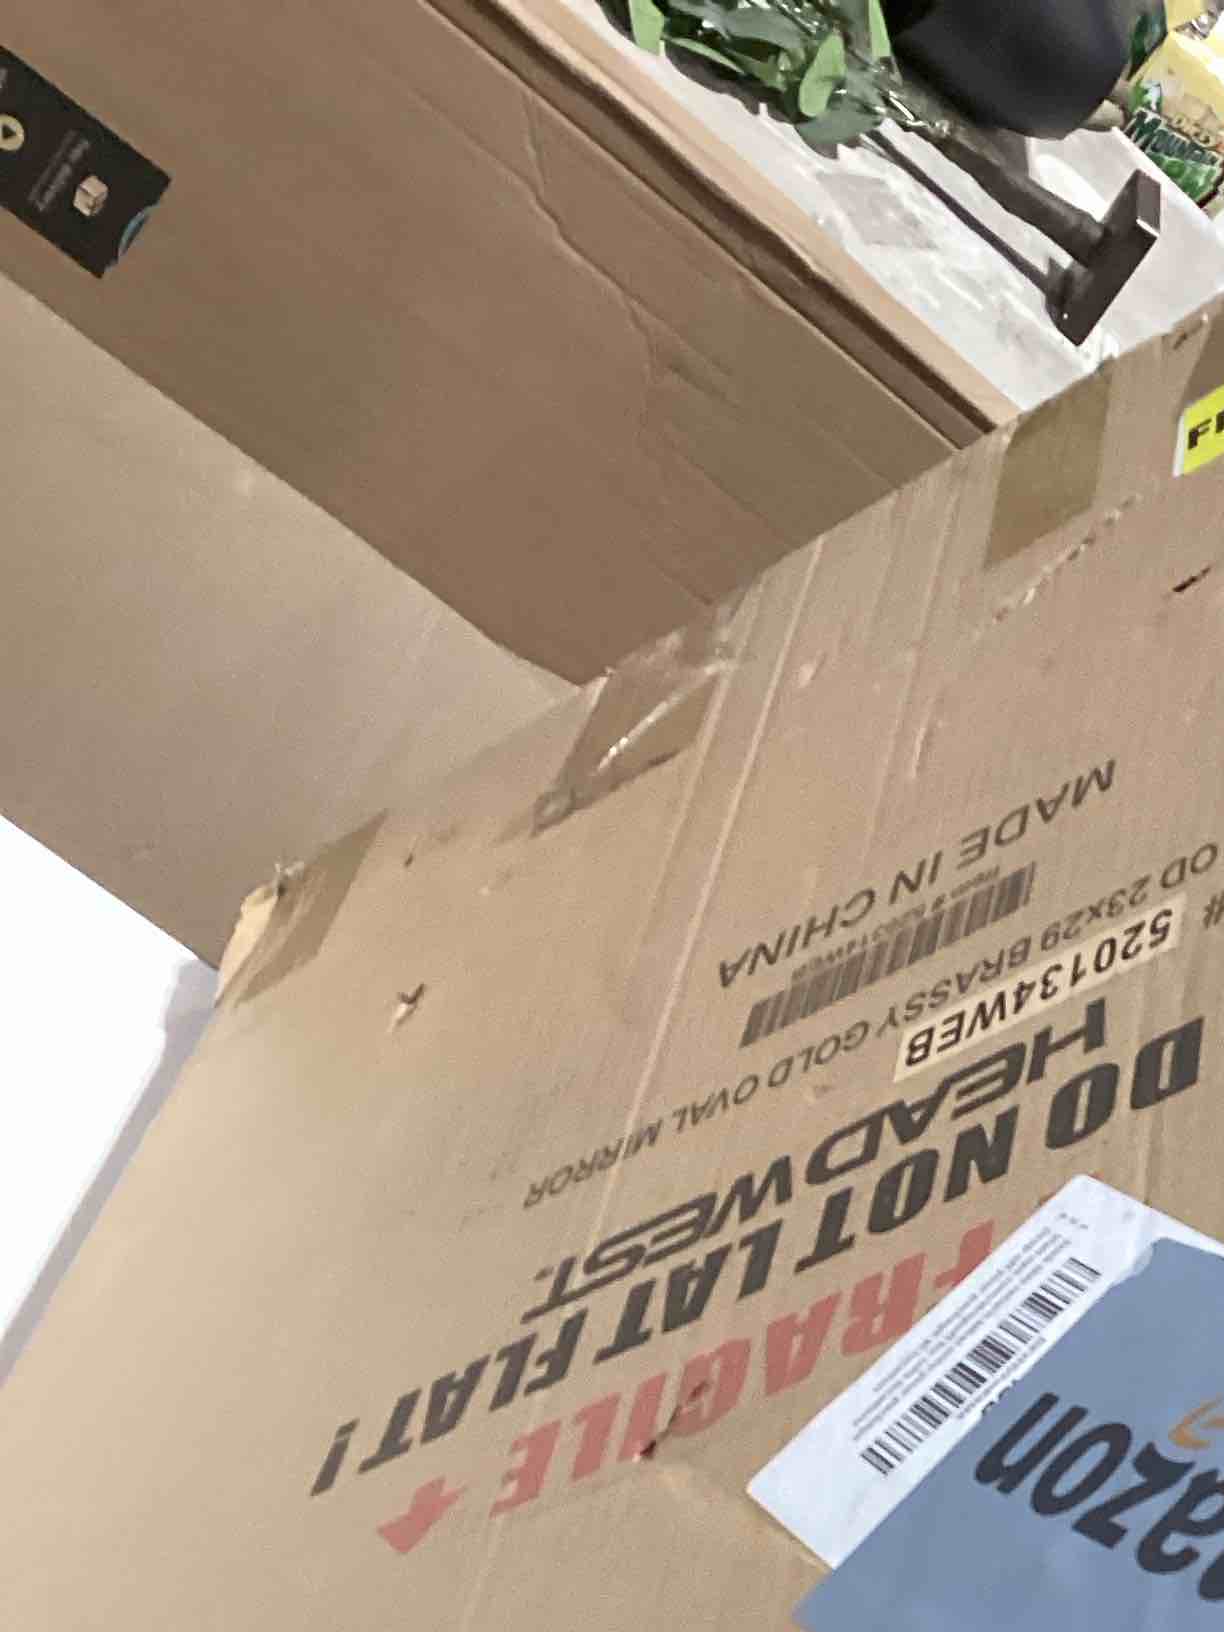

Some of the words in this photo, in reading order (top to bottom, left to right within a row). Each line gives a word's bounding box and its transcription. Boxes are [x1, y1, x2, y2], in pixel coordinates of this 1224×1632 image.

[957, 759, 1115, 868] MADE
[889, 851, 943, 904] IN
[1159, 843, 1219, 890] OD
[719, 888, 875, 989] CHINA
[876, 936, 1031, 1038] BRASSY
[905, 908, 1174, 1067] 520134WEB
[671, 1074, 759, 1133] OVAL
[766, 1020, 869, 1089] GOLD
[1045, 1016, 1204, 1150] DO
[523, 1120, 663, 1209] MIRROR
[795, 1103, 1019, 1274] NOT
[593, 1219, 783, 1365] LAT
